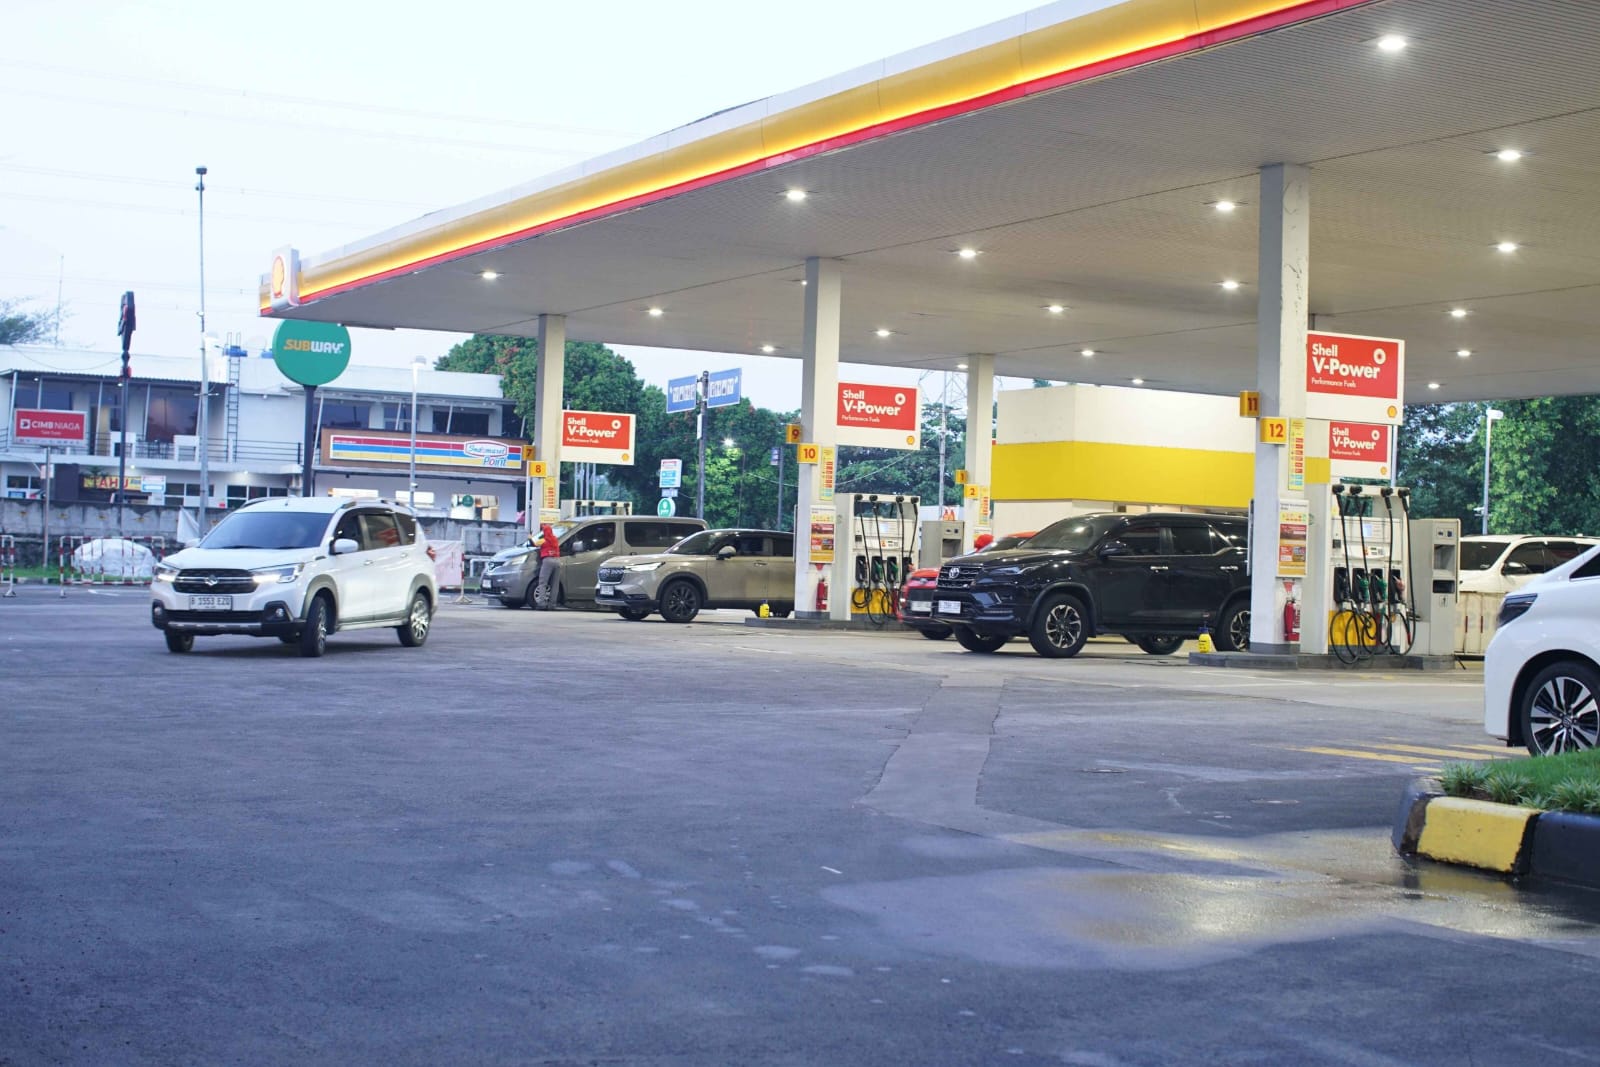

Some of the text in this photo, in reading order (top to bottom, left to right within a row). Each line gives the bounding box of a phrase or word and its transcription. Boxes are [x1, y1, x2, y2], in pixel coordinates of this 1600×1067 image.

[283, 338, 344, 354] SUBWAY
[1312, 343, 1338, 357] Shell
[1312, 356, 1380, 379] V-Power
[1311, 377, 1343, 387] Performance
[842, 389, 865, 400] Shell
[842, 399, 901, 416] V-Power
[1247, 397, 1258, 411] 11
[31, 420, 80, 431] CIMB NIAGA
[567, 417, 586, 426] Shell
[567, 425, 617, 438] V-Power
[792, 428, 800, 440] 9
[1269, 423, 1284, 438] 12
[1332, 427, 1349, 437] Shell
[1332, 436, 1376, 450] V-Power
[526, 448, 533, 457] 7
[804, 447, 816, 459] 10
[483, 456, 507, 467] Point
[535, 464, 542, 474] 8
[970, 487, 975, 496] 2
